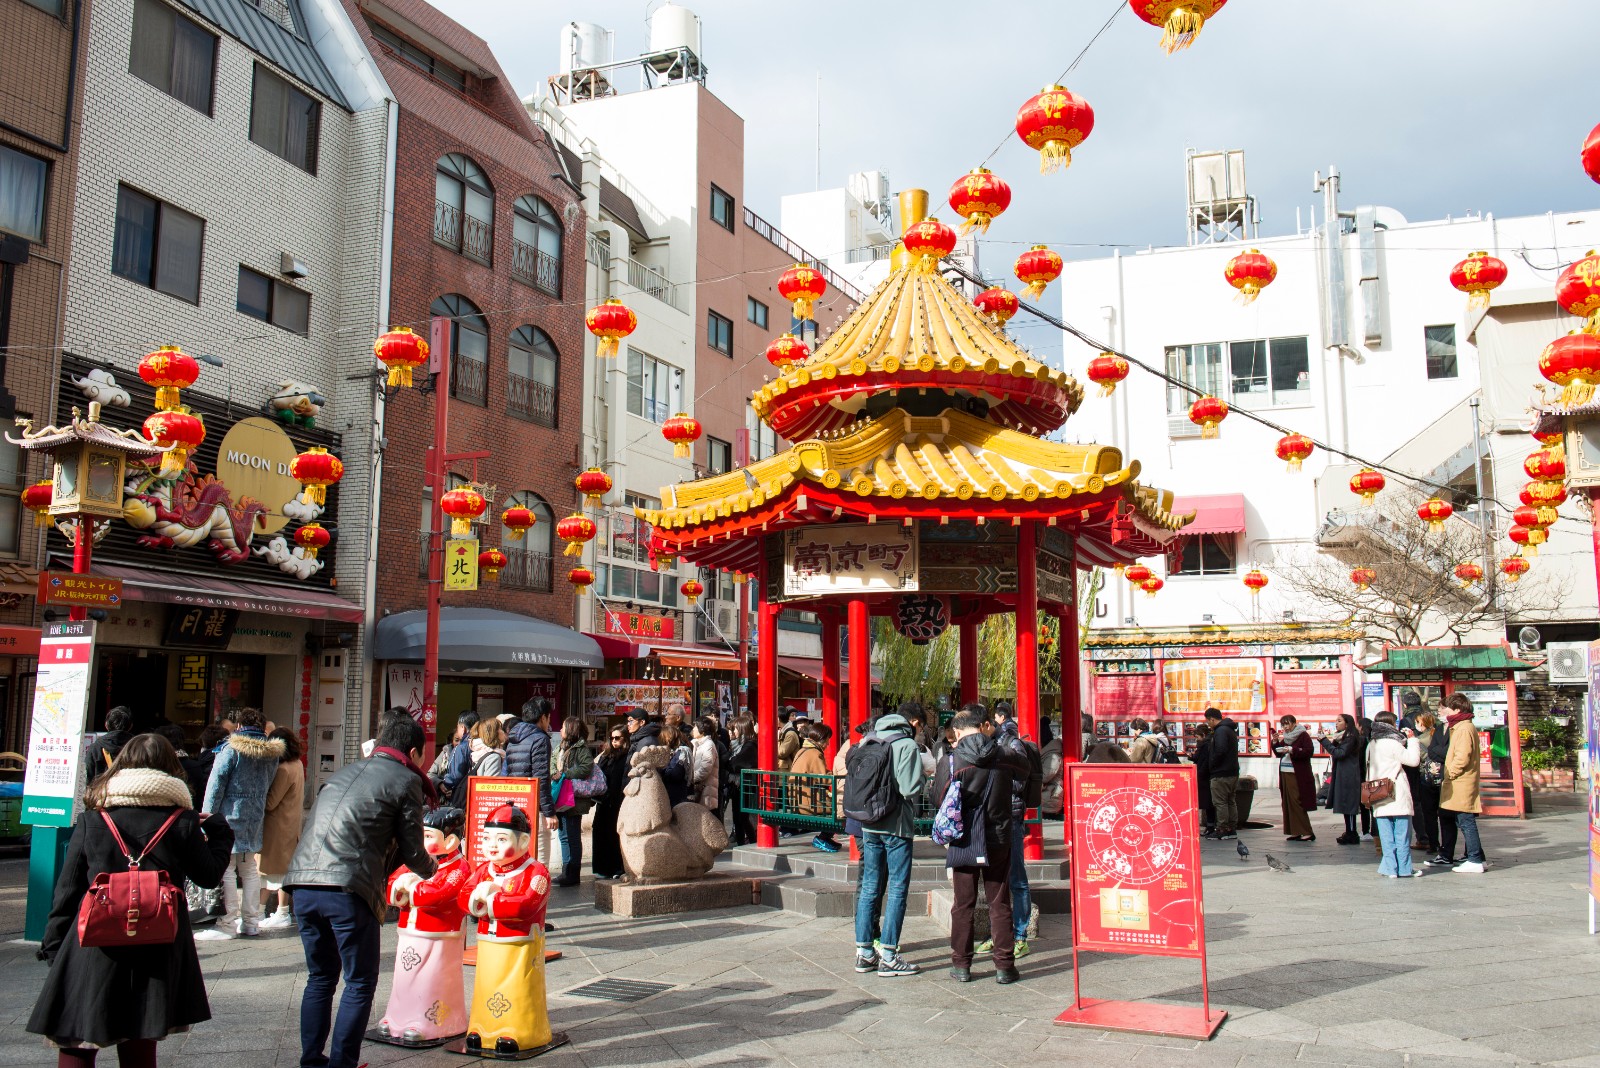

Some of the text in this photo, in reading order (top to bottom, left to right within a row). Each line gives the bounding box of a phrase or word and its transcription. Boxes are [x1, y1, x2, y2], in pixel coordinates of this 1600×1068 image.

[227, 449, 271, 472] MOON
[452, 558, 470, 575] 北
[793, 541, 911, 574] 南京町
[65, 579, 116, 591] 観光トイレ
[207, 599, 284, 612] MOON DRAGON
[898, 594, 946, 638] 熱
[180, 609, 226, 637] 月龍
